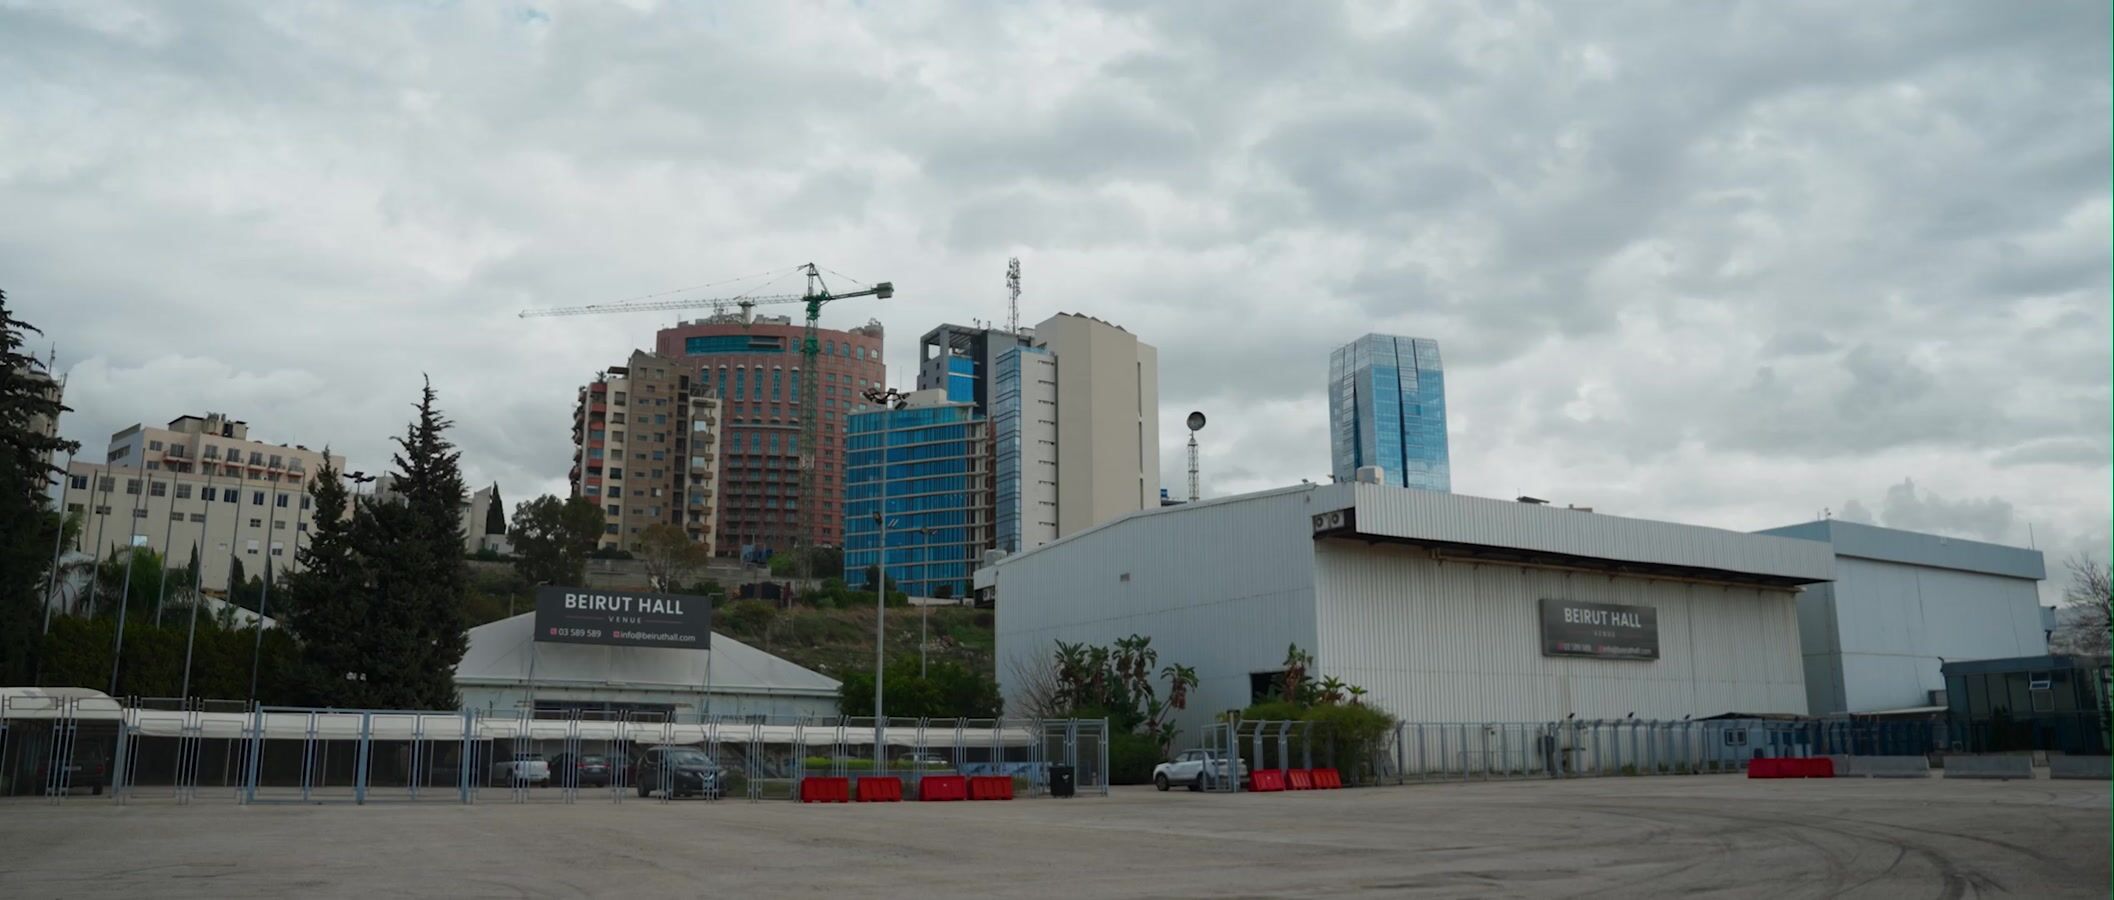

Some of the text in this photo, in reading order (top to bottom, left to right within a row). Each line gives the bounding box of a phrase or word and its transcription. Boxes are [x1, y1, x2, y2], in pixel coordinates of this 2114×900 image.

[565, 593, 684, 615] BEIRUT HALL
[608, 615, 642, 624] VENUE
[1564, 607, 1642, 628] BEIRUT HALL
[558, 628, 602, 638] 03 589 589
[621, 632, 696, 642] info@beiruthall.com
